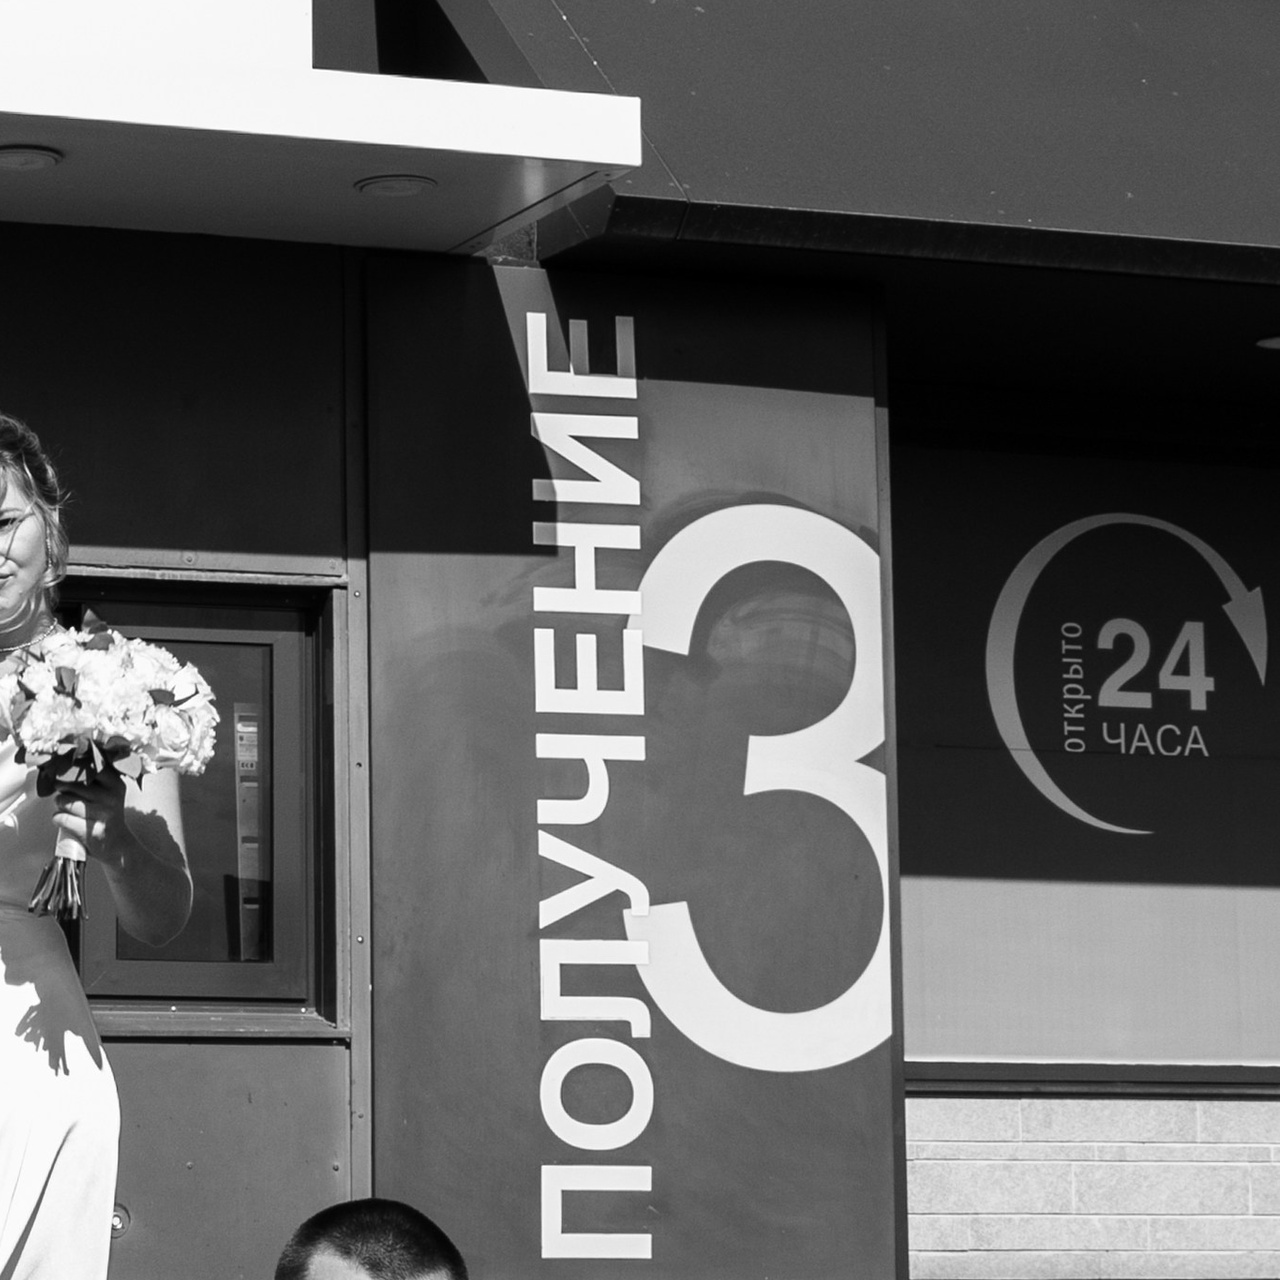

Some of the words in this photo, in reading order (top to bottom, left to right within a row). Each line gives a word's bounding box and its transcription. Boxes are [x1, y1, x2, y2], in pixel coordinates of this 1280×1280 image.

[526, 312, 654, 1259] ПОЛУЧЕНИЕ
[622, 503, 892, 1072] 3
[1097, 618, 1215, 711] 24
[1102, 722, 1210, 757] ЧАСА
